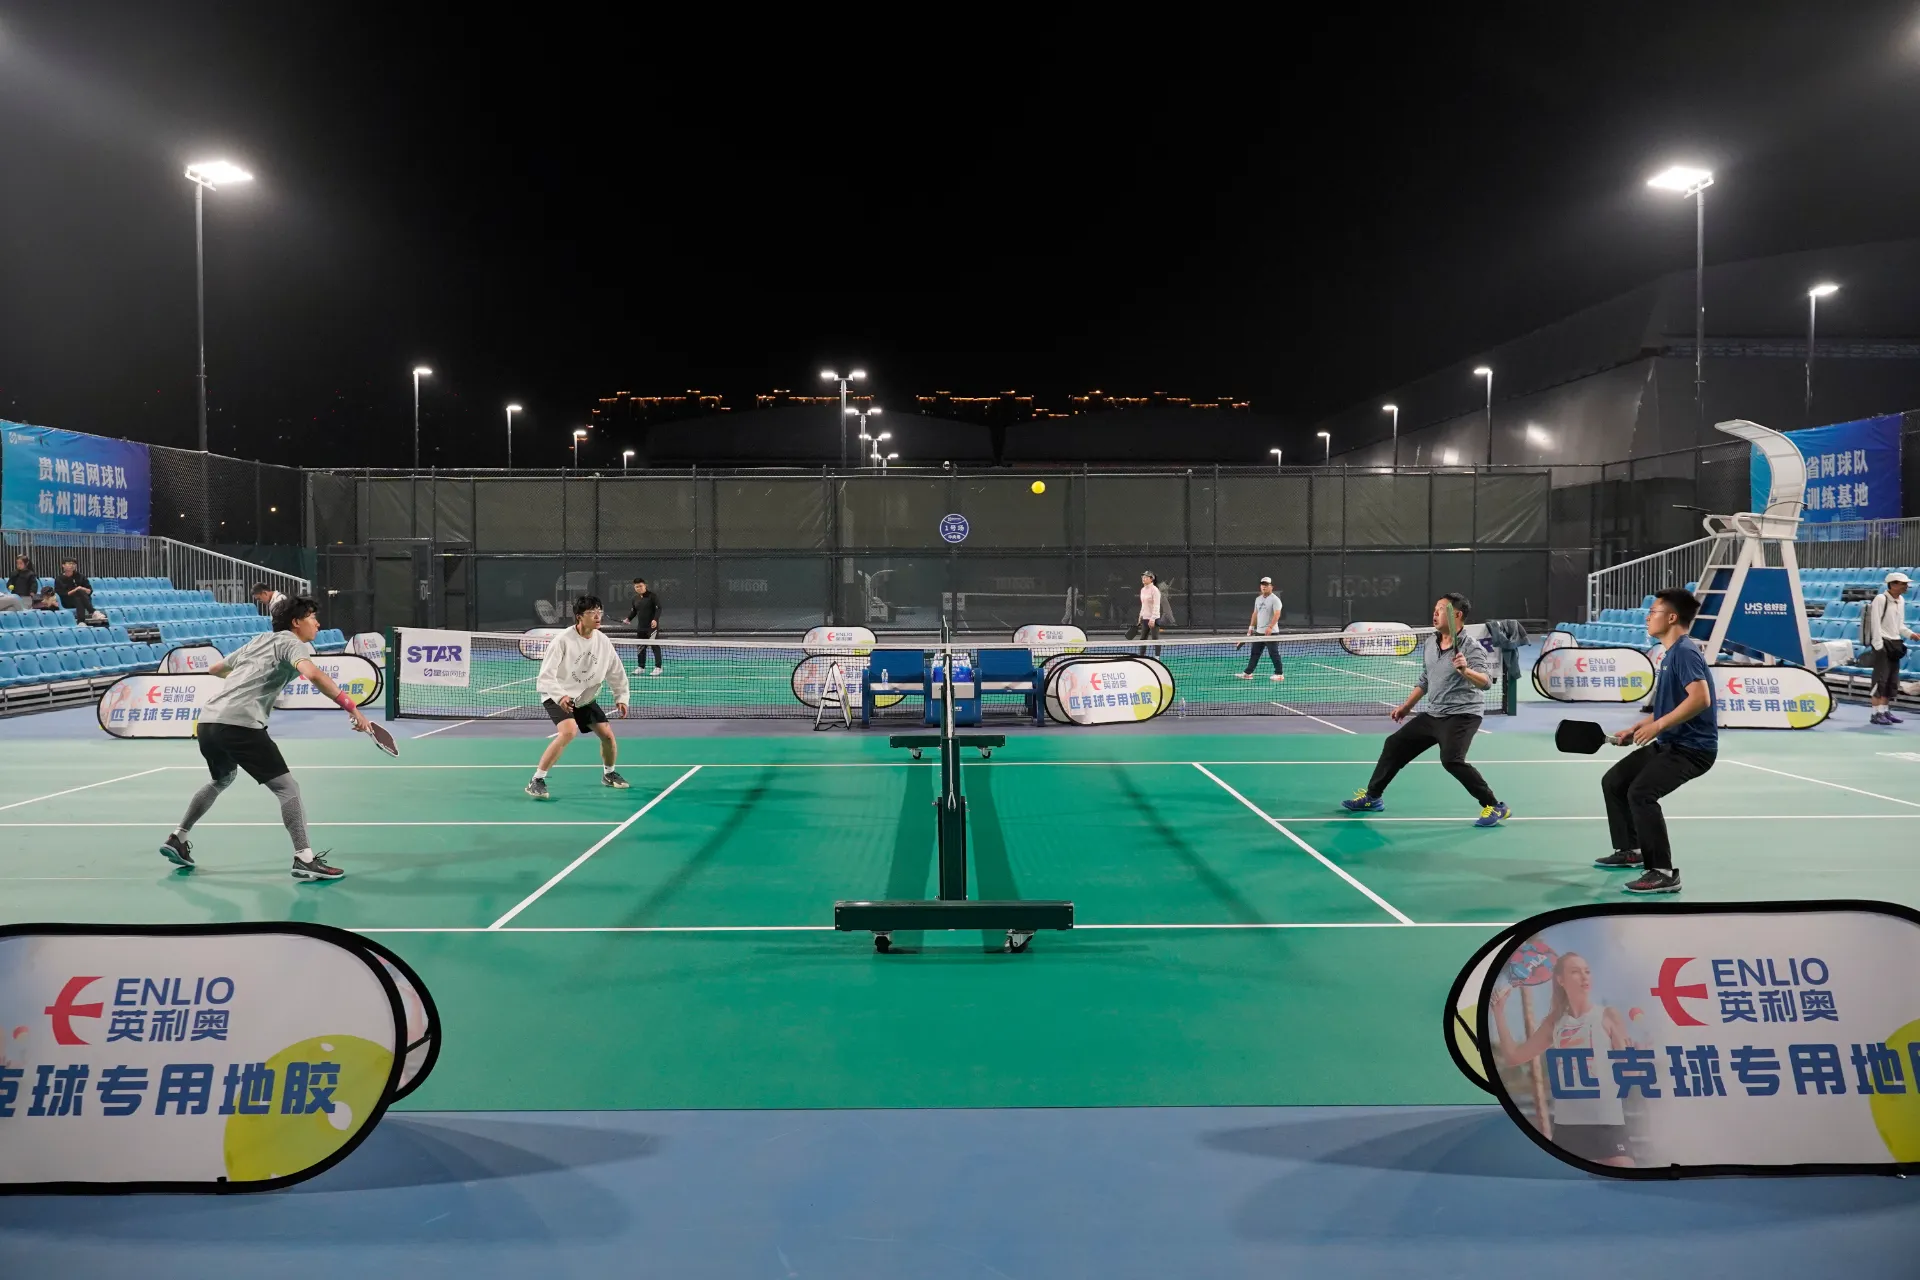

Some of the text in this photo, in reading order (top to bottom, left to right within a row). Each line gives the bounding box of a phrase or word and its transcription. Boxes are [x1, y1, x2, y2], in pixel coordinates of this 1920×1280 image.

[39, 457, 127, 489] 贵州省网球队
[39, 490, 128, 519] 杭州训练基地
[1744, 603, 1763, 611] UHS
[407, 646, 462, 663] STAR
[1102, 672, 1126, 680] ENLIO
[1550, 676, 1643, 688] 匹克球专用地胶
[1711, 957, 1829, 987] ENLIO
[113, 976, 235, 1006] ENLIO
[1717, 989, 1839, 1023] 英利奥
[106, 1008, 230, 1042] 英利奥
[1545, 1042, 1920, 1100] 匹克球专用地
